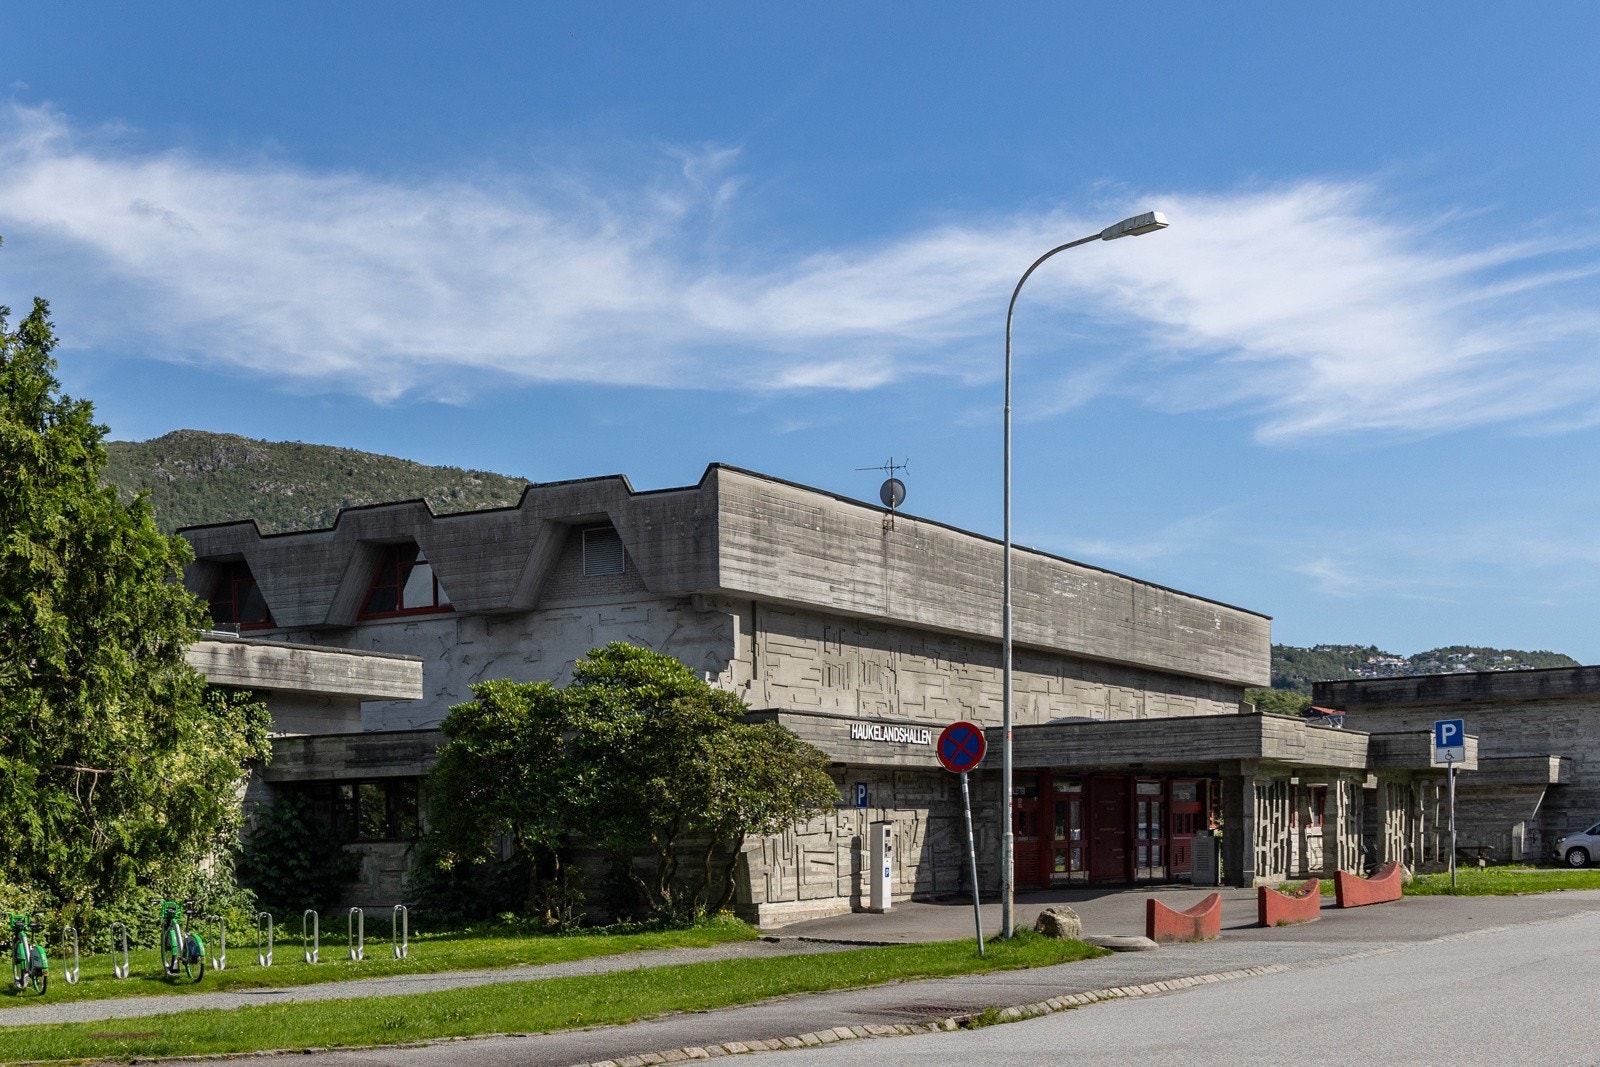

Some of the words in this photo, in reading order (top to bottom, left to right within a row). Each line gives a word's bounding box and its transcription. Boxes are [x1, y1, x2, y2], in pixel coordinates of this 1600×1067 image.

[851, 723, 931, 745] HAUKELANDSHALLEN
[1442, 723, 1456, 745] P
[858, 784, 865, 805] P
